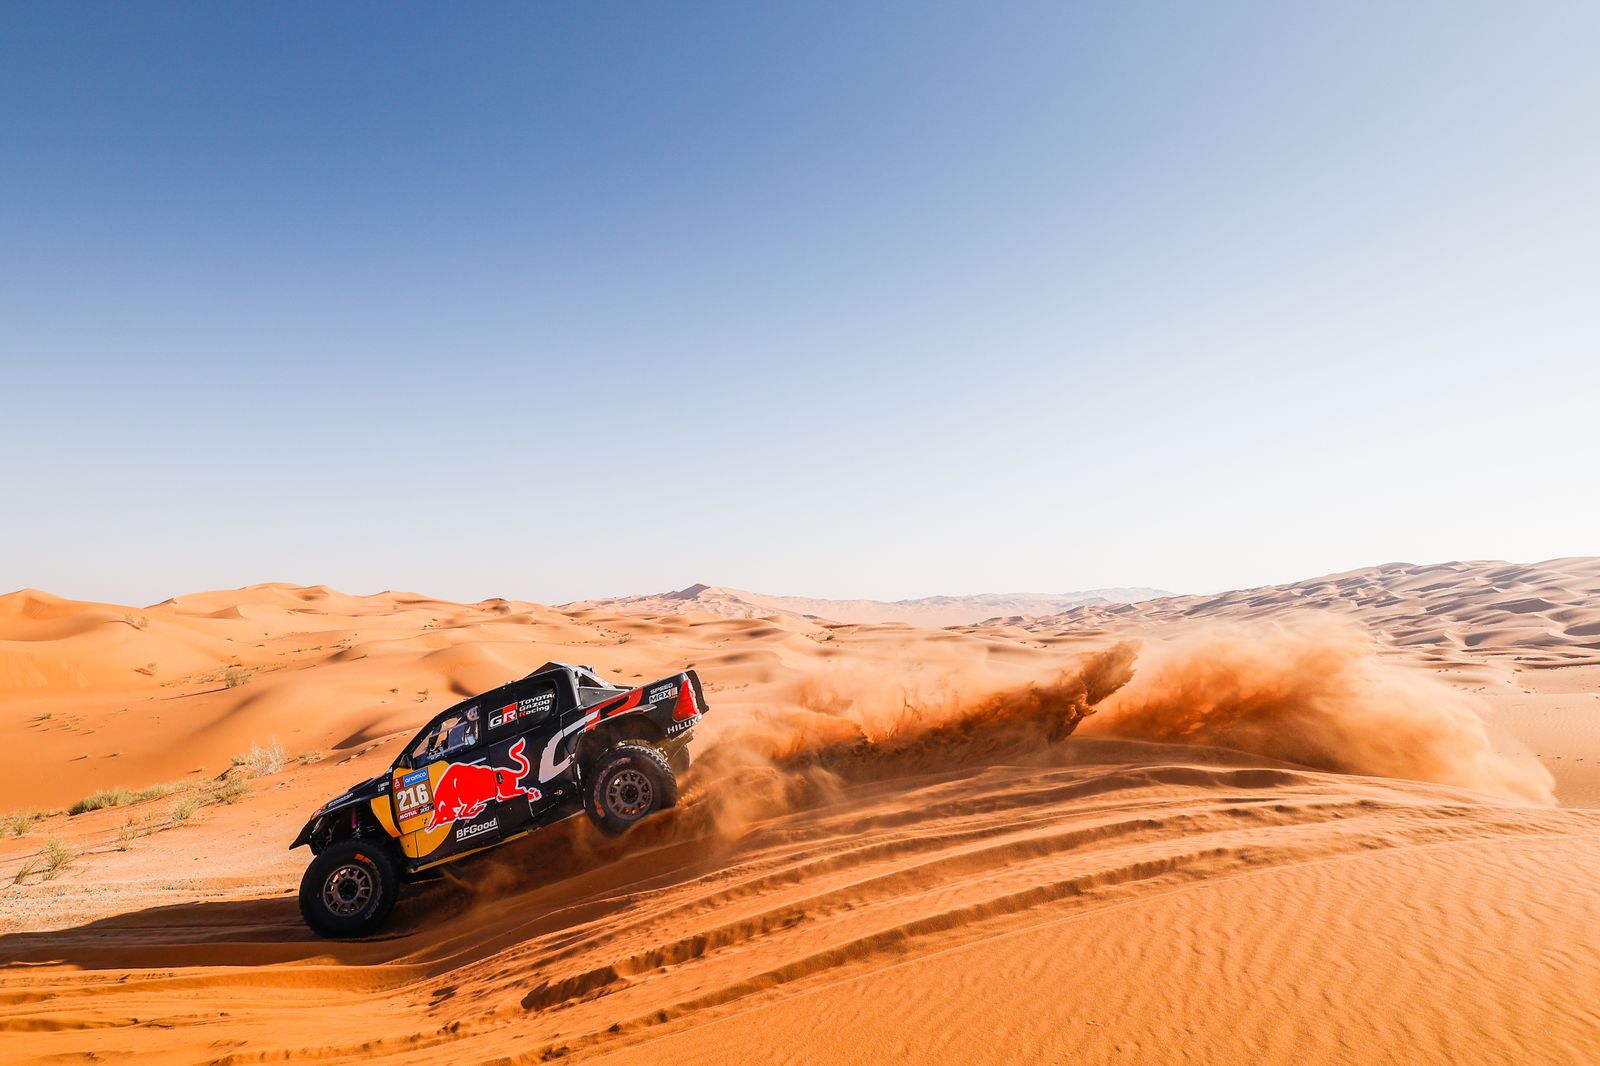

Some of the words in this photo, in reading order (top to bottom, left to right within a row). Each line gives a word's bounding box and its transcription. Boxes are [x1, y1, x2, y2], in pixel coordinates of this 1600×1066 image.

[650, 682, 673, 695] SPEED
[519, 693, 554, 706] TOYOTA
[650, 690, 670, 703] MAX
[519, 699, 550, 712] GAZOO
[519, 705, 550, 717] Racing
[489, 709, 517, 728] GR
[667, 716, 698, 734] HILUX
[405, 772, 427, 783] aramco
[397, 783, 429, 812] 216
[400, 810, 417, 820] MOTUL
[456, 817, 498, 839] BFGood
